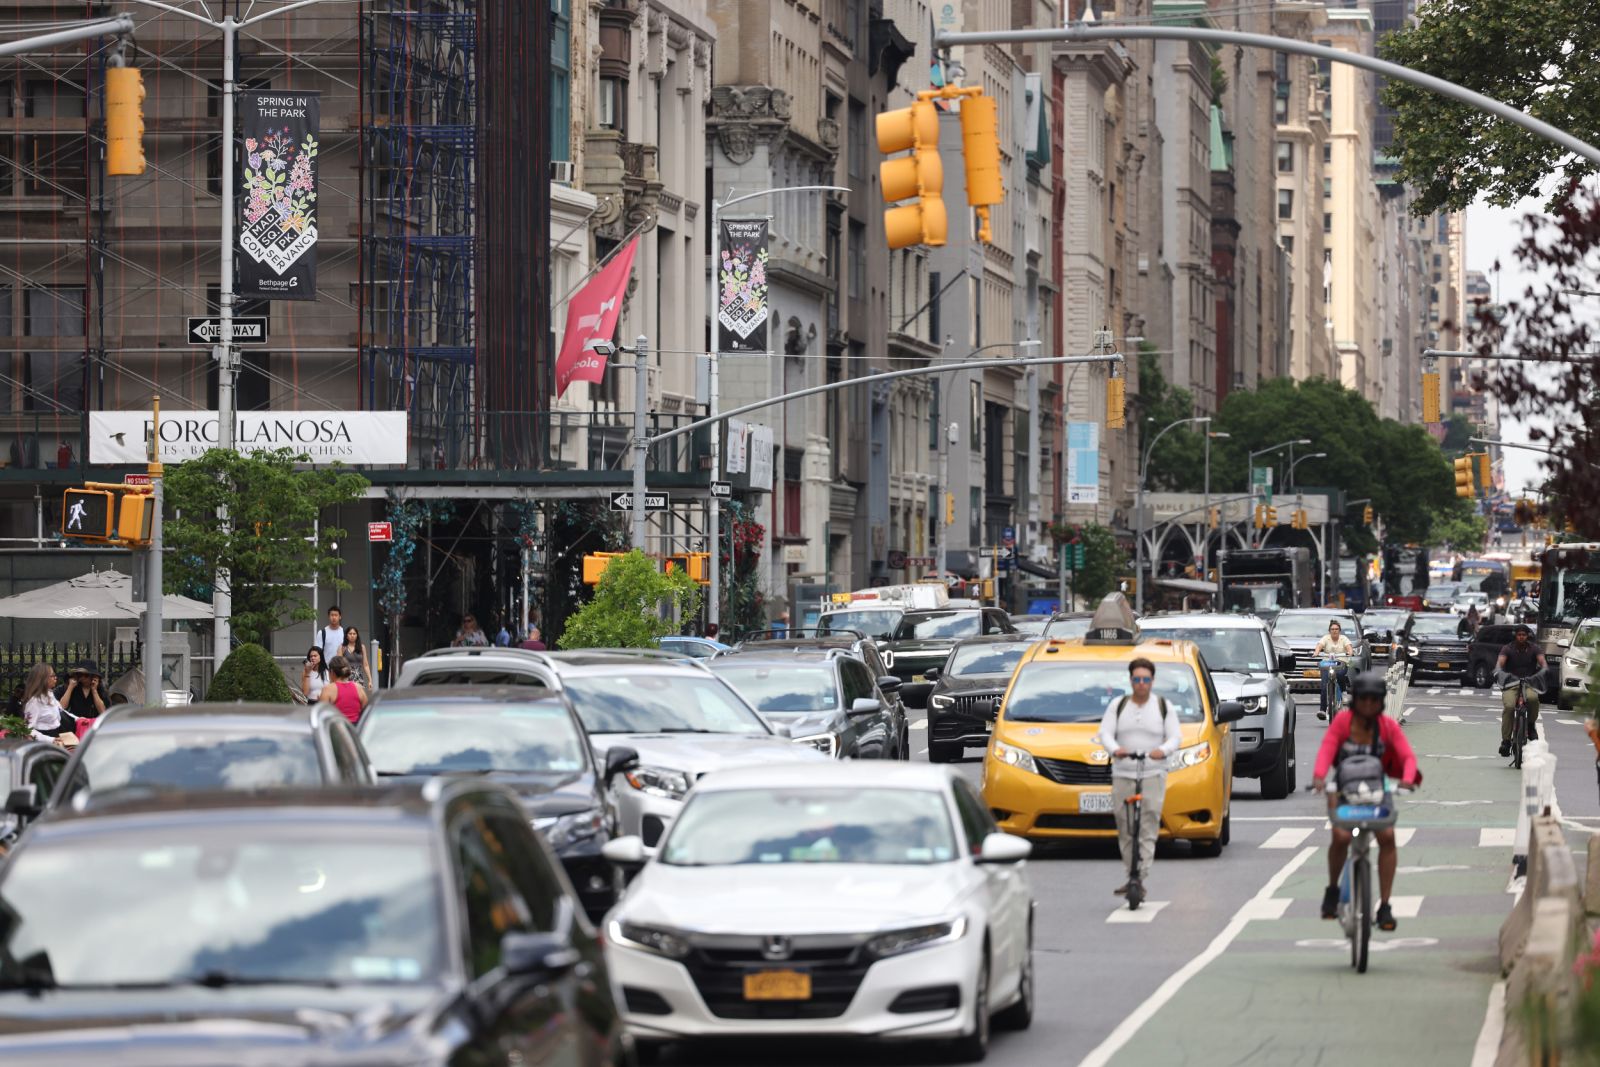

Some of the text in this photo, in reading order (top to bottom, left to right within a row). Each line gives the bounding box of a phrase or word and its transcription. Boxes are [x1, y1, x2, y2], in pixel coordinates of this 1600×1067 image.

[257, 97, 307, 107] SPRING IN
[258, 108, 306, 118] THE PARK
[251, 213, 279, 236] MAD.
[261, 230, 281, 246] SQ.
[278, 232, 298, 248] PK.
[258, 279, 289, 288] Bethpage
[200, 326, 256, 336] ONE WAY
[143, 419, 352, 443] PORCLANOSA
[645, 497, 661, 506] WAY
